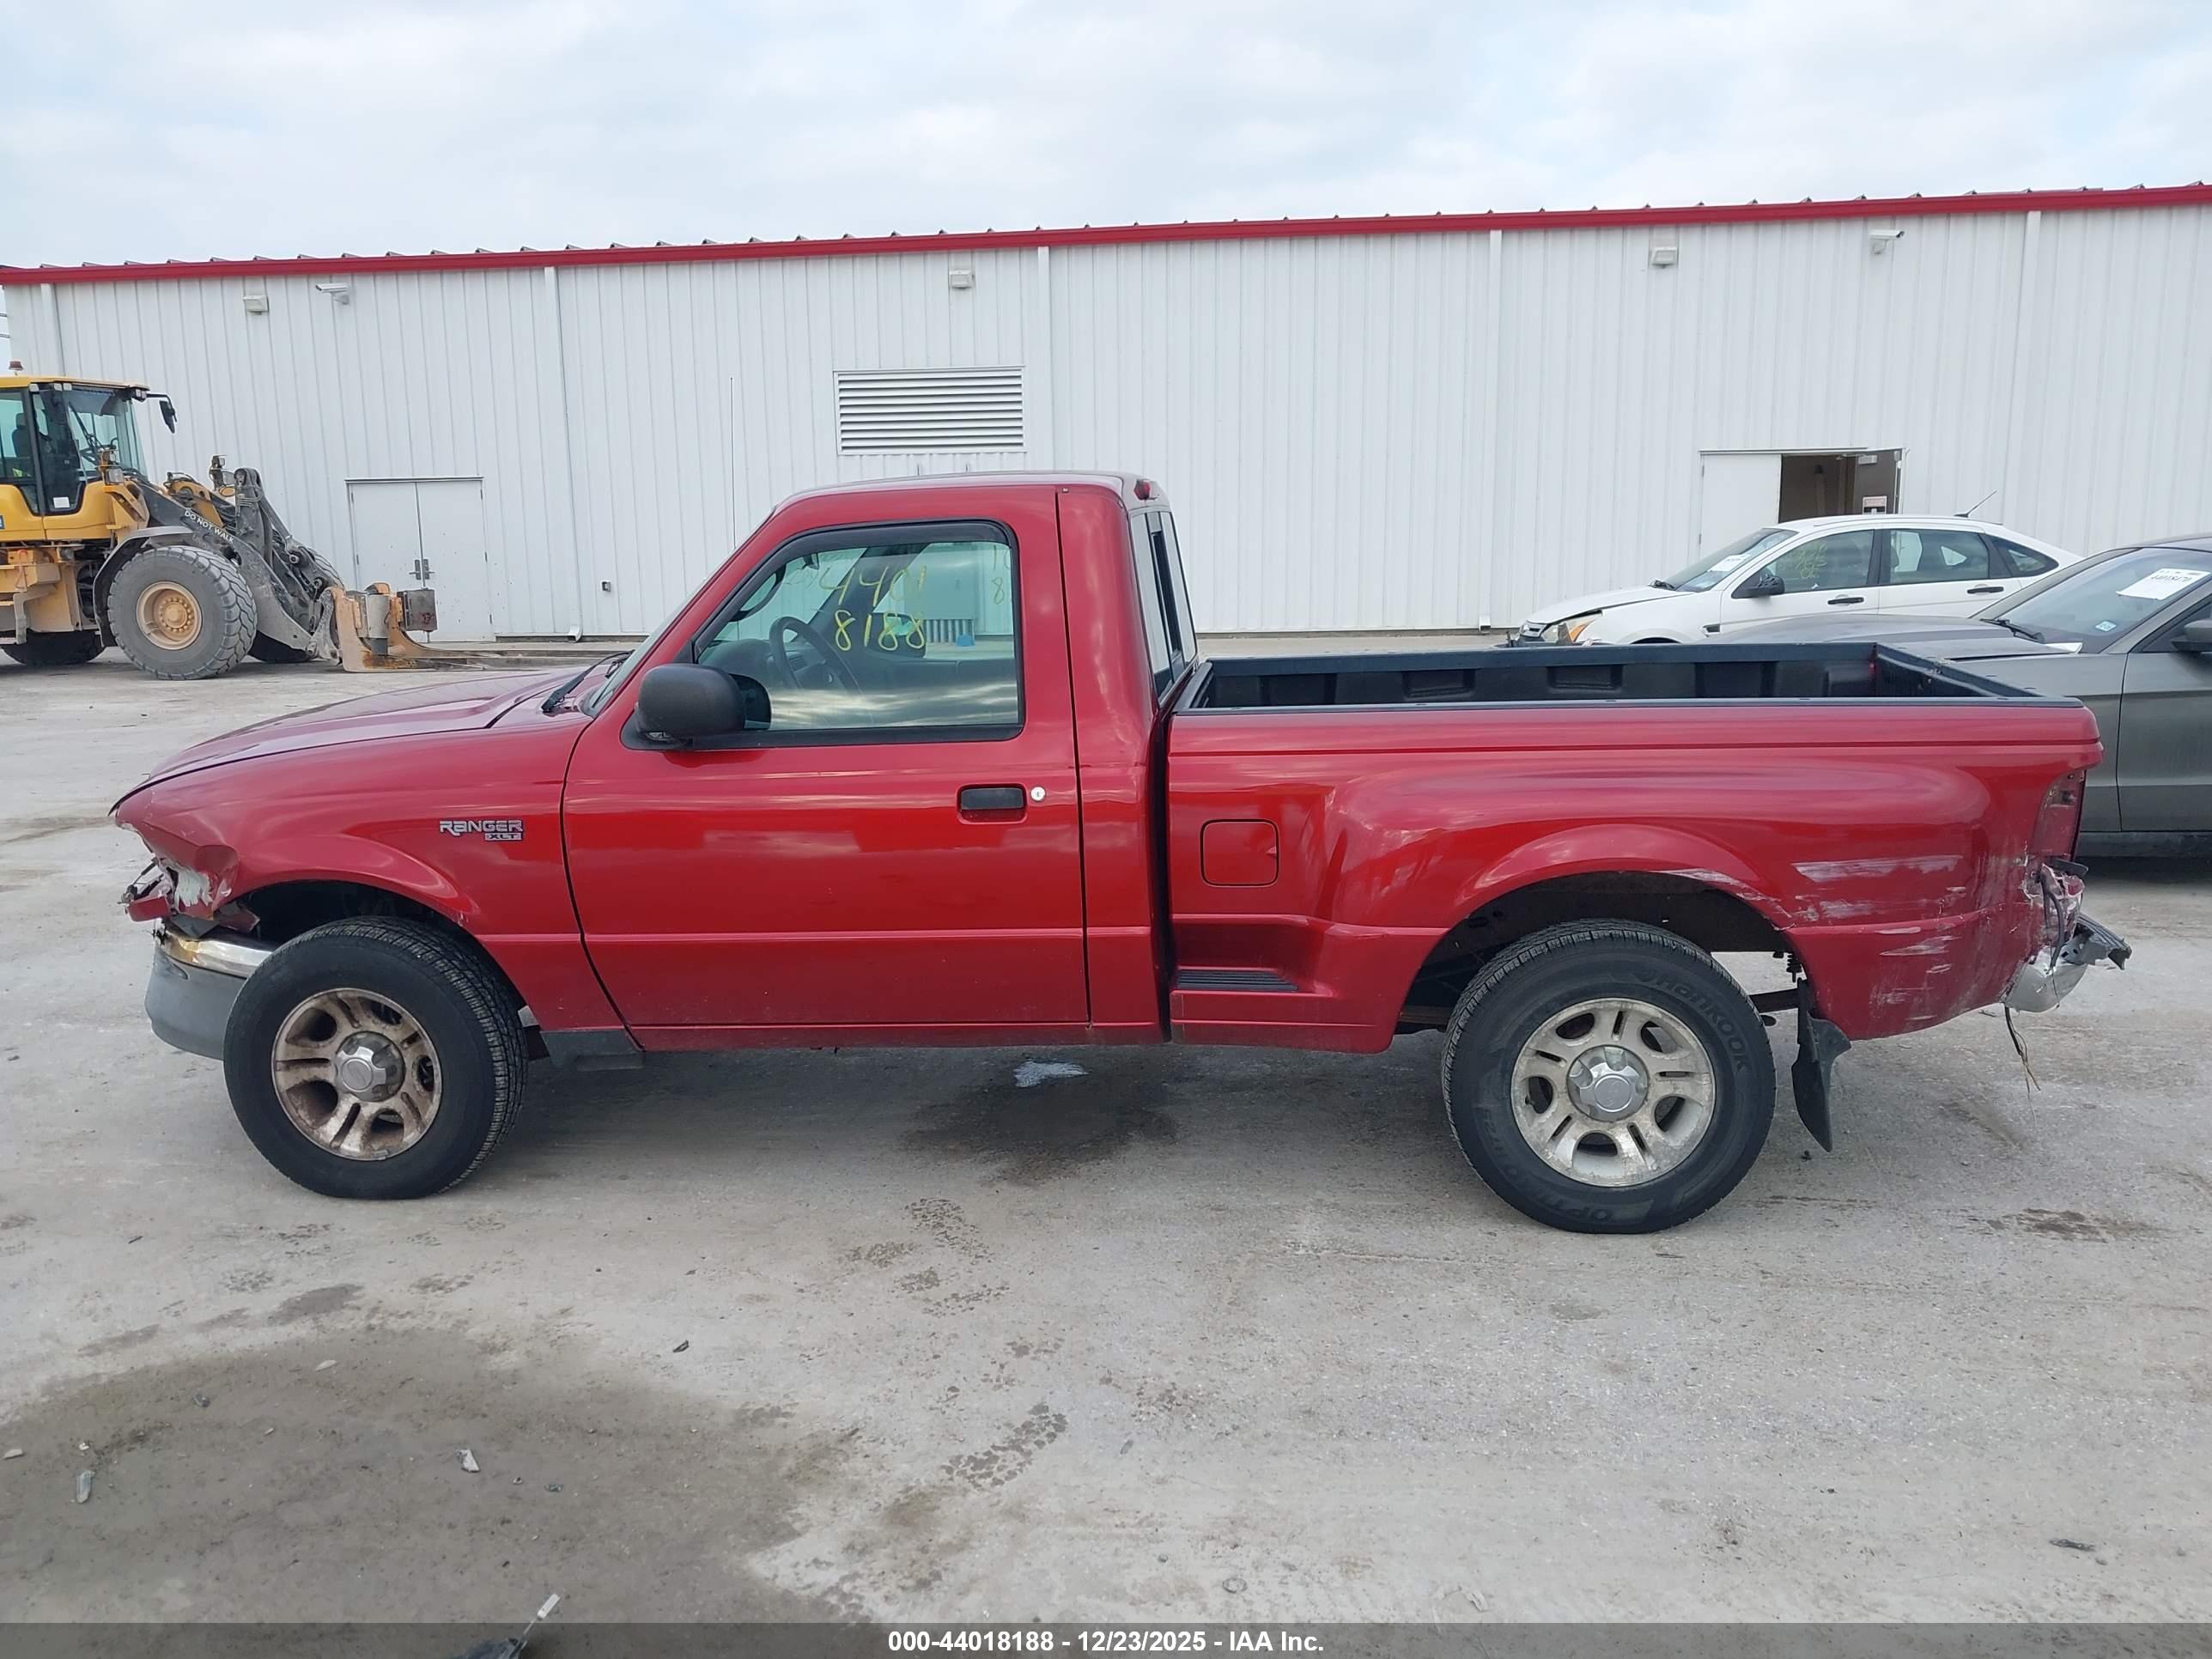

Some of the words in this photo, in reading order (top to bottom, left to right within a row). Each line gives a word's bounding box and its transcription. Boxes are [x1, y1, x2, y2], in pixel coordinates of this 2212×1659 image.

[184, 510, 197, 520] DO
[197, 517, 213, 530] NOT
[214, 527, 234, 544] WALK
[819, 563, 927, 607] 4401
[834, 609, 926, 652] 8188
[439, 820, 524, 836] RANGER
